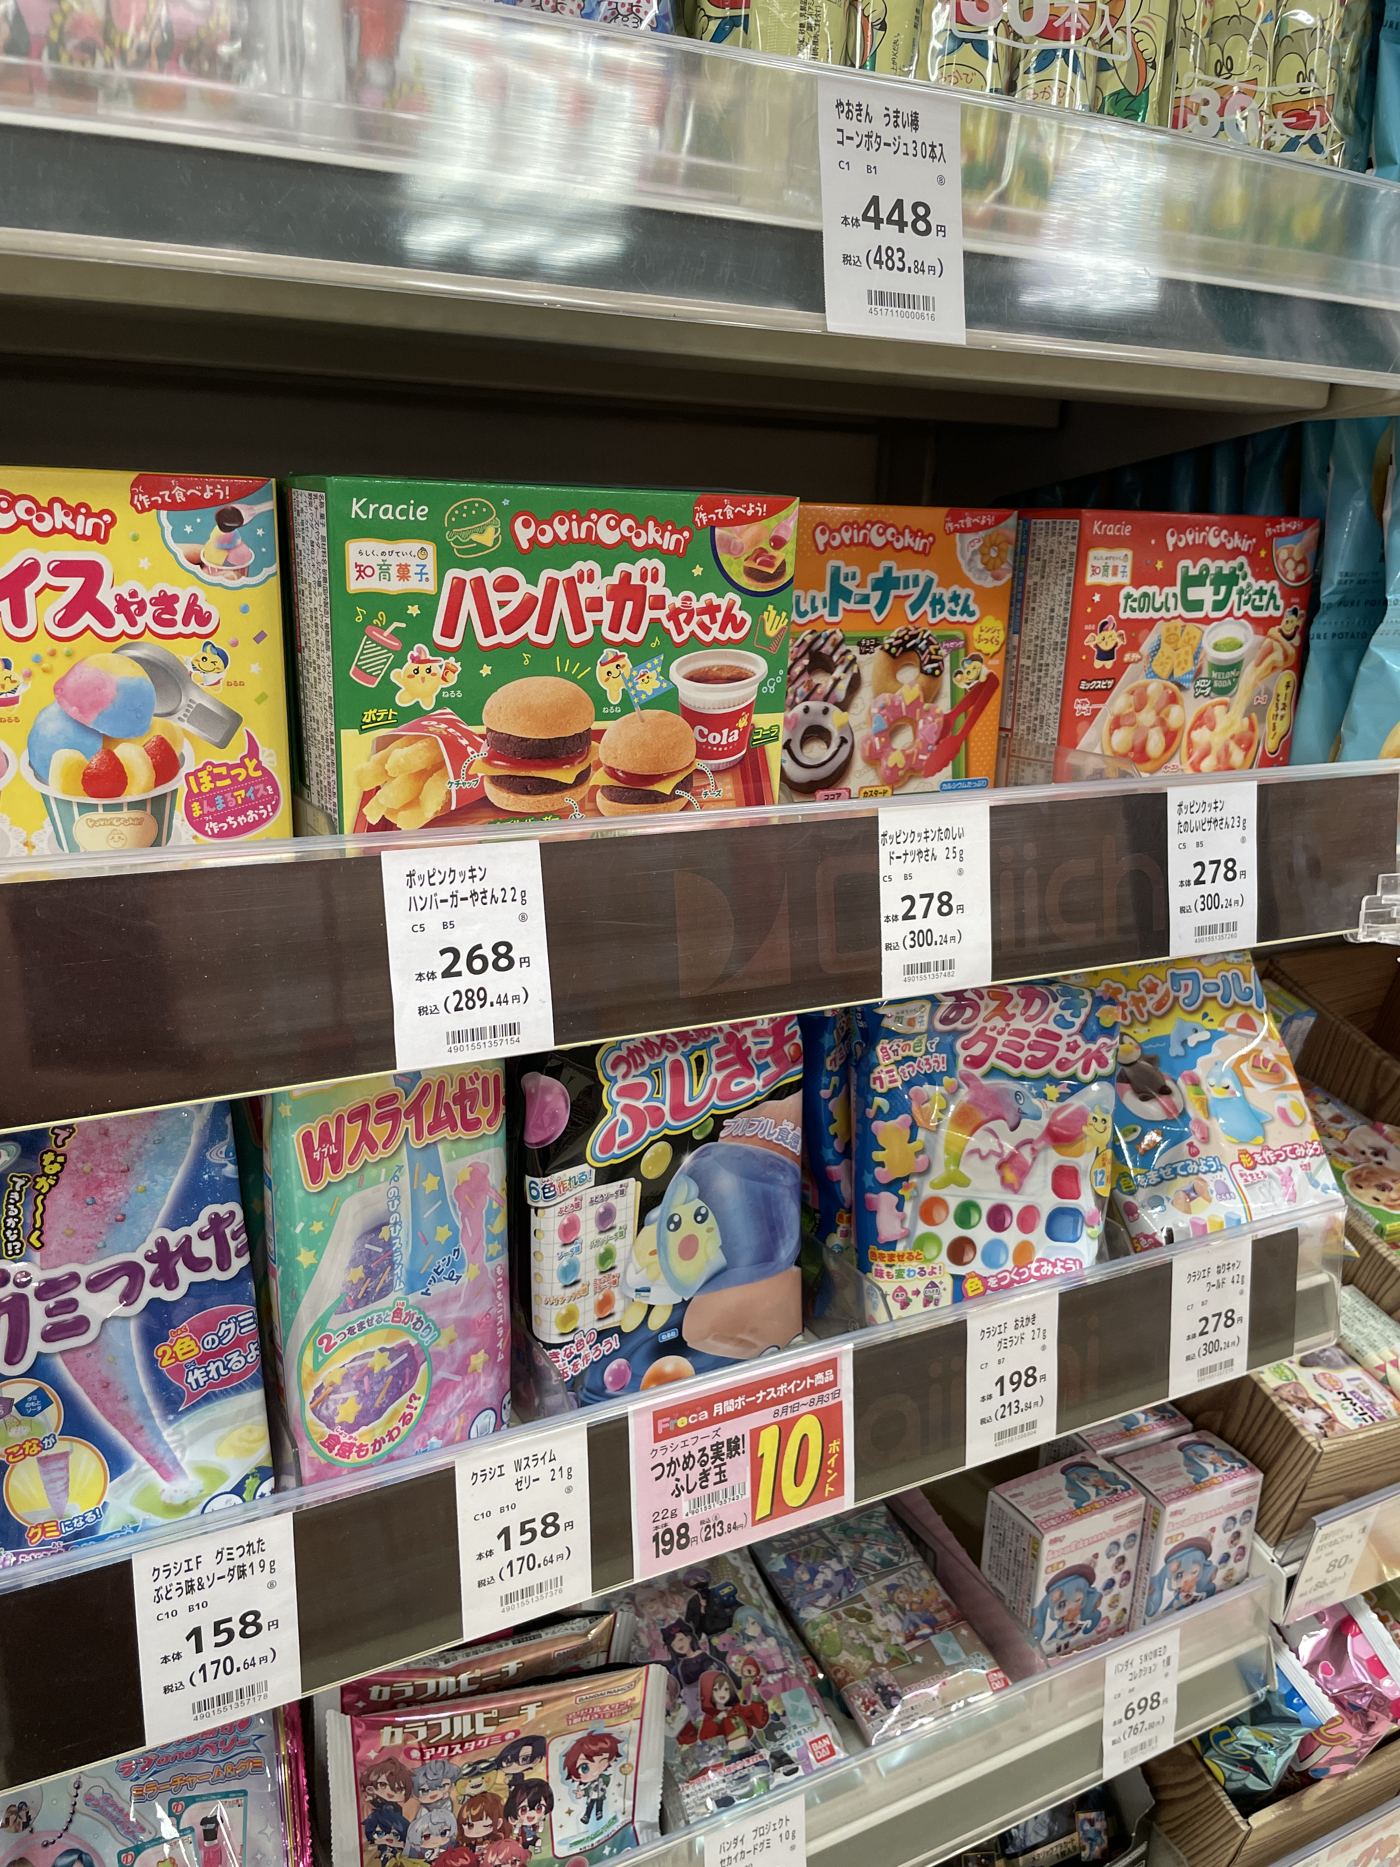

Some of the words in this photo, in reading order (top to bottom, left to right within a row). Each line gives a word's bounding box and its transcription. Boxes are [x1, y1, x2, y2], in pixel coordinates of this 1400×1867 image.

[835, 98, 873, 124] やおきん
[883, 106, 920, 133] うまい棒
[836, 127, 946, 164] コーンポタージュ30本入
[838, 160, 850, 171] C1
[866, 164, 877, 175] B1
[868, 307, 936, 322] 4517110000616
[134, 485, 229, 510] 作って食べよう!
[351, 497, 429, 521] Kracie
[695, 502, 767, 527] 作って食べよう!
[1093, 520, 1132, 536] Kracie
[438, 562, 750, 641] ハンバーガーやさん
[795, 565, 976, 618] しいドーナツやさん
[1122, 562, 1281, 614] たのしいピザやさん
[362, 708, 397, 723] ポテト
[693, 726, 739, 745] Cola
[753, 725, 779, 739] コーラ
[189, 757, 263, 794] ぽこっと
[447, 779, 480, 789] ケチャップ
[191, 784, 274, 817] まんまるアイスを
[702, 789, 722, 799] チーズ
[863, 789, 888, 799] カスタード
[1176, 799, 1225, 815] ポッピンクッキン
[205, 804, 273, 836] 作っちゃおう!
[1177, 815, 1247, 835] たのしいピザやさん23g
[880, 826, 965, 847] ポッピンクッキンたのしい
[888, 847, 937, 866] ドーナツやさん
[945, 846, 964, 862] 25g
[405, 865, 488, 889] ポッピンクッキン
[882, 875, 893, 883] C5
[903, 873, 913, 881] B5
[408, 886, 527, 912] ハンバーガーやさん22g
[411, 923, 426, 933] C5
[442, 920, 455, 930] B5
[903, 970, 955, 983] 4901551357482
[936, 984, 1088, 1032] おえかき
[447, 1036, 521, 1054] 4901551357154
[872, 1056, 946, 1090] グミをつくろう!
[300, 1071, 506, 1187] Wスライムゼリ
[313, 1144, 338, 1160] ダブル
[528, 1169, 592, 1201] 6色作れる!
[870, 1252, 923, 1262] 色をまぜると
[421, 1245, 461, 1297] トッピング
[874, 1265, 942, 1279] 味も変わるよ!
[318, 1307, 438, 1353] 2つをまぜると色がわり!
[980, 1322, 1008, 1341] クラシエF
[1014, 1313, 1036, 1331] おえかき
[997, 1333, 1025, 1352] グミランド
[712, 1369, 835, 1418] 月間ボーナスポイント商品
[320, 1393, 422, 1459] 食感もかわる!?
[650, 1427, 722, 1459] クラシエフーズ
[470, 1464, 505, 1486] クラシエ
[514, 1449, 557, 1473] Wスライム
[650, 1433, 746, 1482] つかめる実験!
[755, 1413, 823, 1521] 10
[824, 1438, 841, 1497] ポイント
[515, 1474, 540, 1492] ゼリー
[550, 1466, 573, 1482] 21g
[670, 1462, 729, 1498] ふしぎ玉
[473, 1510, 491, 1522] C10
[499, 1502, 517, 1514] B10
[652, 1507, 678, 1524] 22g
[27, 1508, 103, 1544] グミになる!
[151, 1554, 202, 1583] クラシエF
[215, 1537, 266, 1563] グミつれた
[153, 1558, 276, 1604] ぶどう味&ソーダ味19g
[156, 1609, 178, 1622] C10
[188, 1600, 209, 1613] B10
[368, 1660, 525, 1702] カラフルピーチ
[193, 1692, 268, 1722] 4901551357178
[381, 1701, 543, 1746] カラフルピーチ
[422, 1736, 503, 1760] アクスタグミ
[719, 1834, 745, 1854] バンダイ
[752, 1816, 790, 1840] プロジェクト
[720, 1838, 771, 1867] セカイカードグミ
[779, 1830, 796, 1843] 10g
